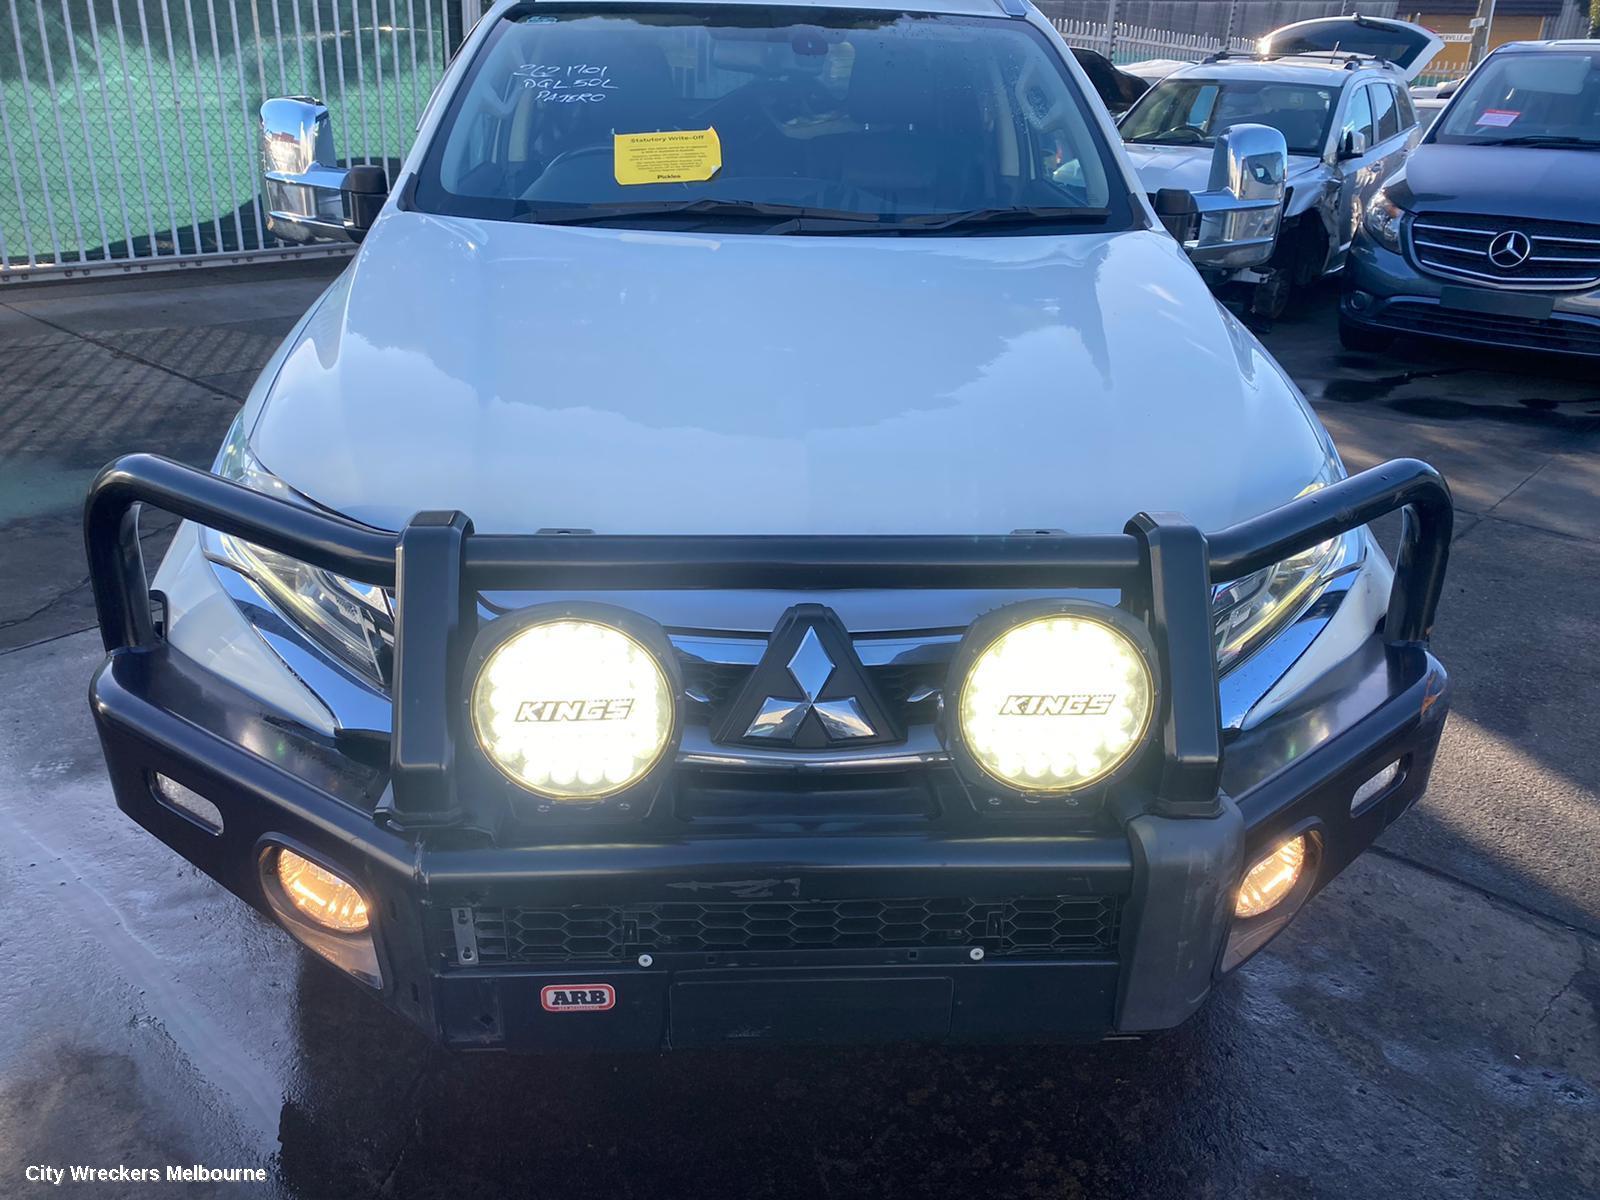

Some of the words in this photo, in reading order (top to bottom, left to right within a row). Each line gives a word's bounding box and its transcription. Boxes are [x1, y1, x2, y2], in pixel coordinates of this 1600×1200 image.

[536, 90, 606, 103] PAJERO
[515, 698, 635, 722] KINGS
[998, 694, 1116, 716] KINGS
[552, 990, 607, 1005] ARB
